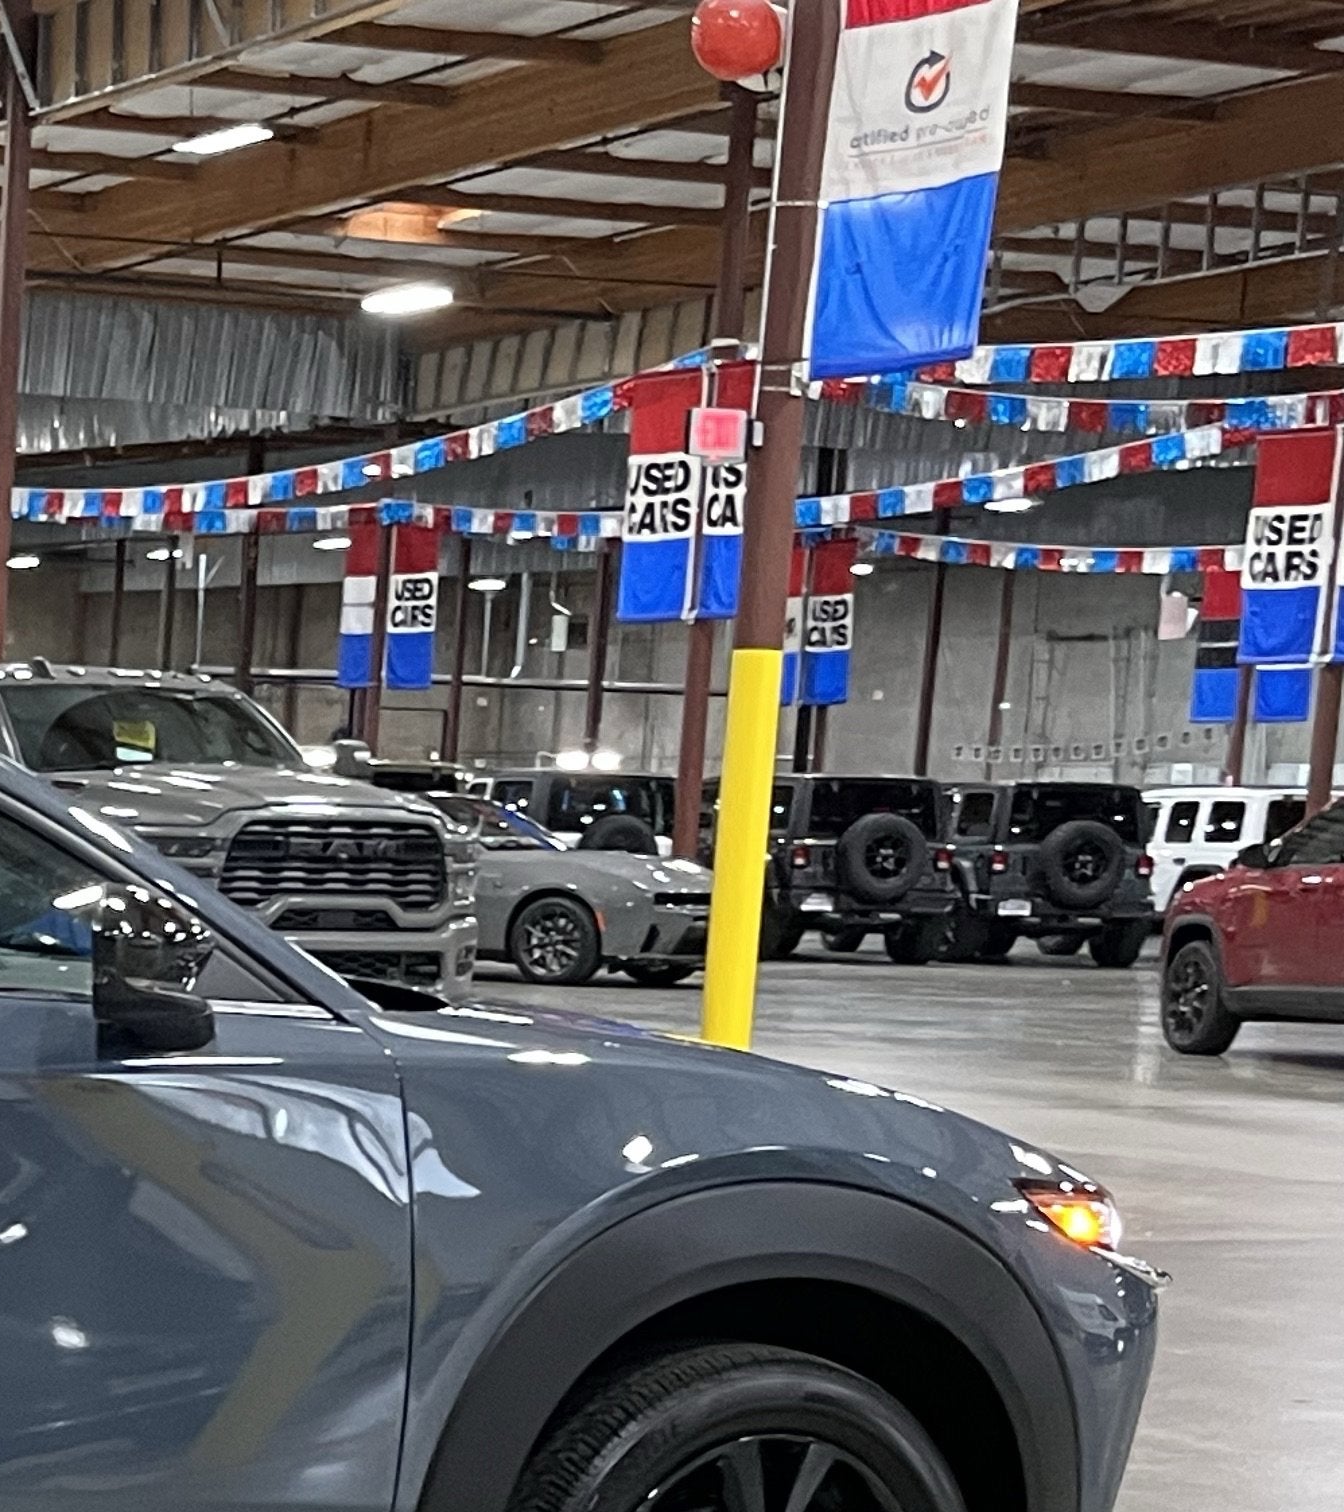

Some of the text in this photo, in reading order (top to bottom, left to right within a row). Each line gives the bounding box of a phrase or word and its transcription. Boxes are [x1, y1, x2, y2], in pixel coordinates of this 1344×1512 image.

[850, 125, 910, 149] ctified
[1254, 513, 1322, 546] USED
[1249, 549, 1320, 583] CARS
[395, 578, 434, 601] USED
[813, 598, 849, 622] USD
[808, 624, 849, 647] CAS
